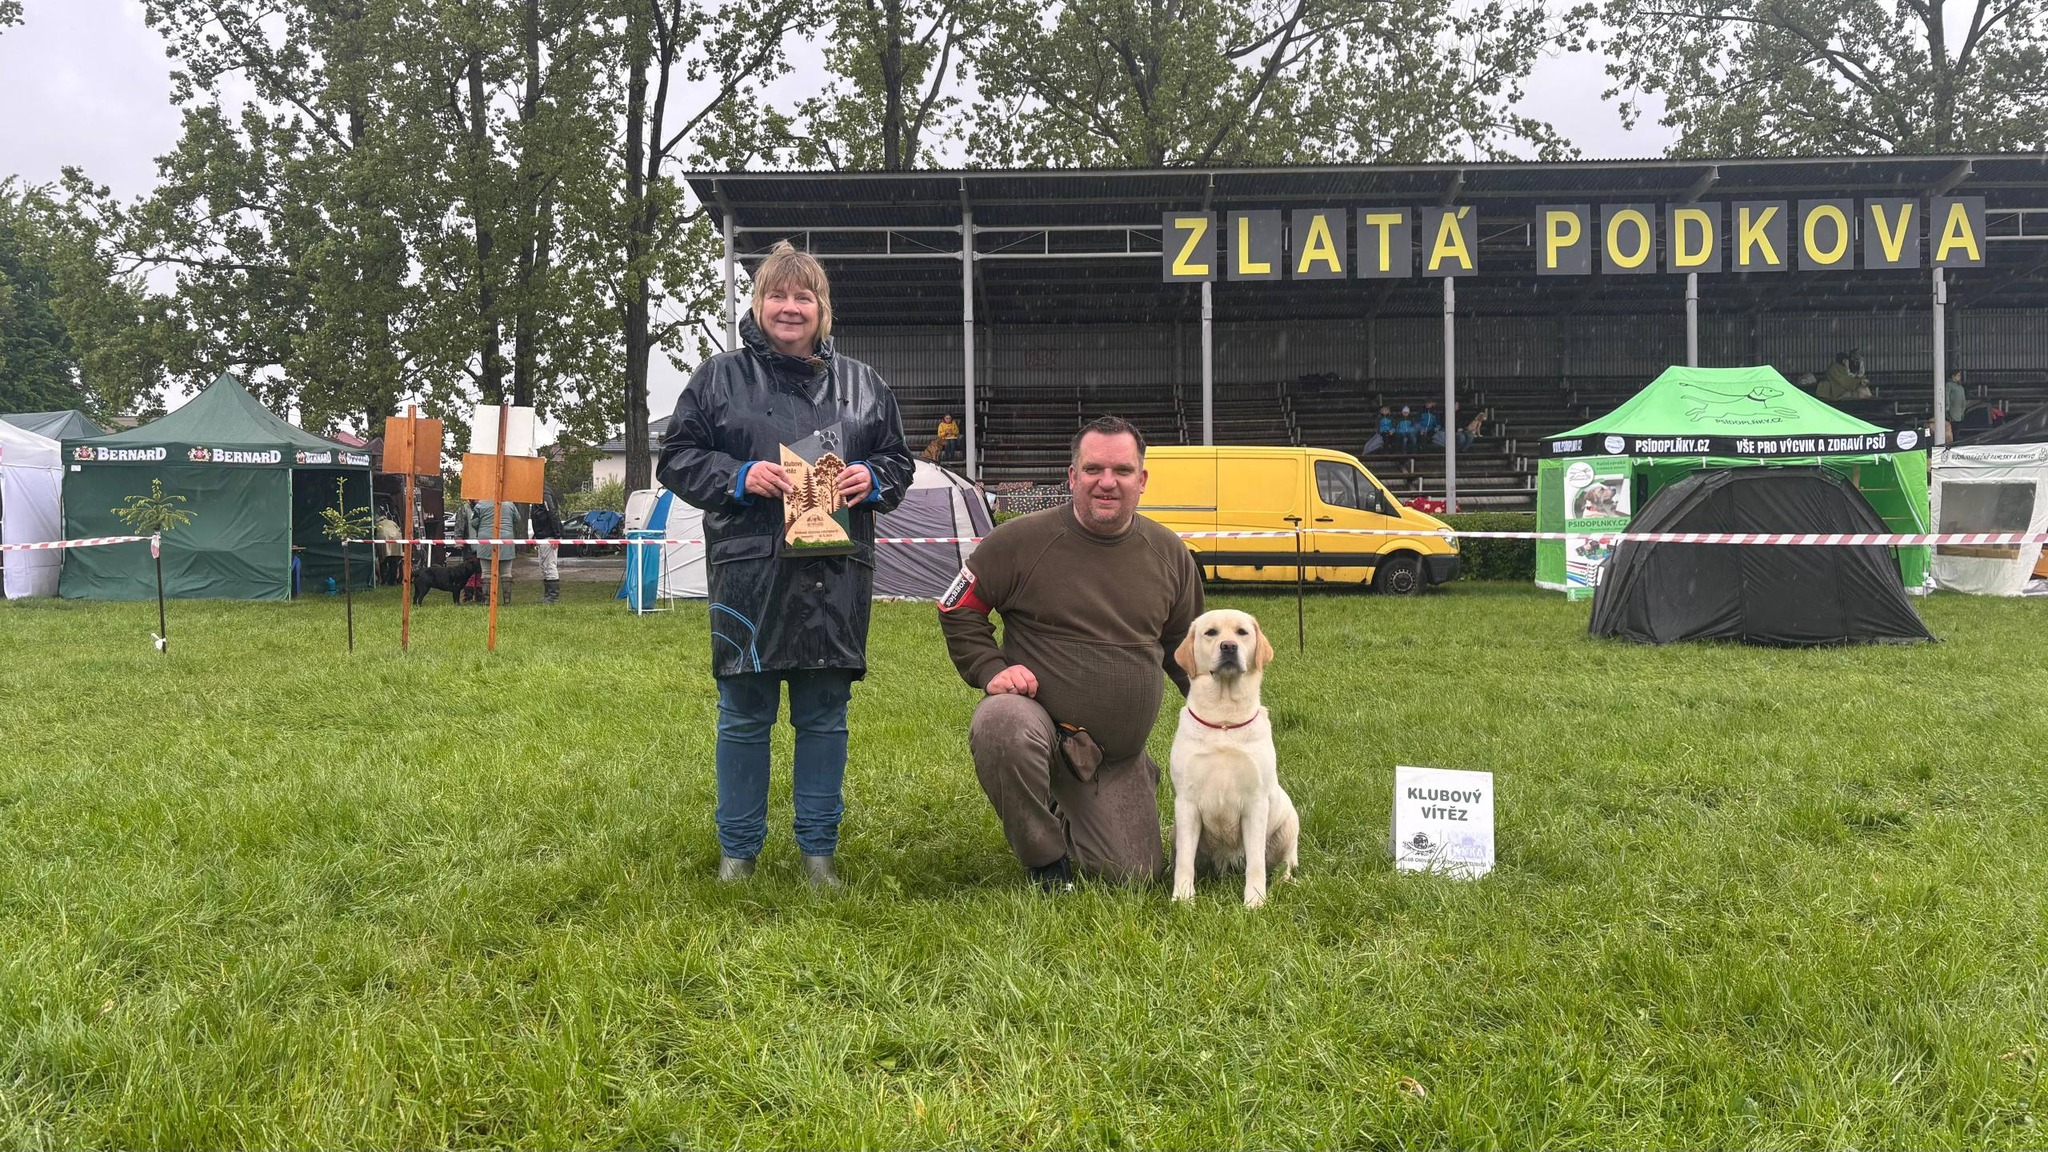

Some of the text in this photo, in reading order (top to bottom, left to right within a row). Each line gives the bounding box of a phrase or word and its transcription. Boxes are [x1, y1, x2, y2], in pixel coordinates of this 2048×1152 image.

[1172, 202, 1982, 275] ZLATÁ PODKOVA
[1635, 438, 1710, 453] PSÍDOPLŇKY.CZ
[1736, 434, 1886, 454] VŠE PRO VÝCVIK A ZDRAVÍ PSŮ
[97, 447, 167, 461] BERNARD
[212, 449, 282, 464] BERNARD
[1408, 787, 1482, 804] KLUBOVÝ
[1421, 804, 1468, 821] VÍTĚZ
